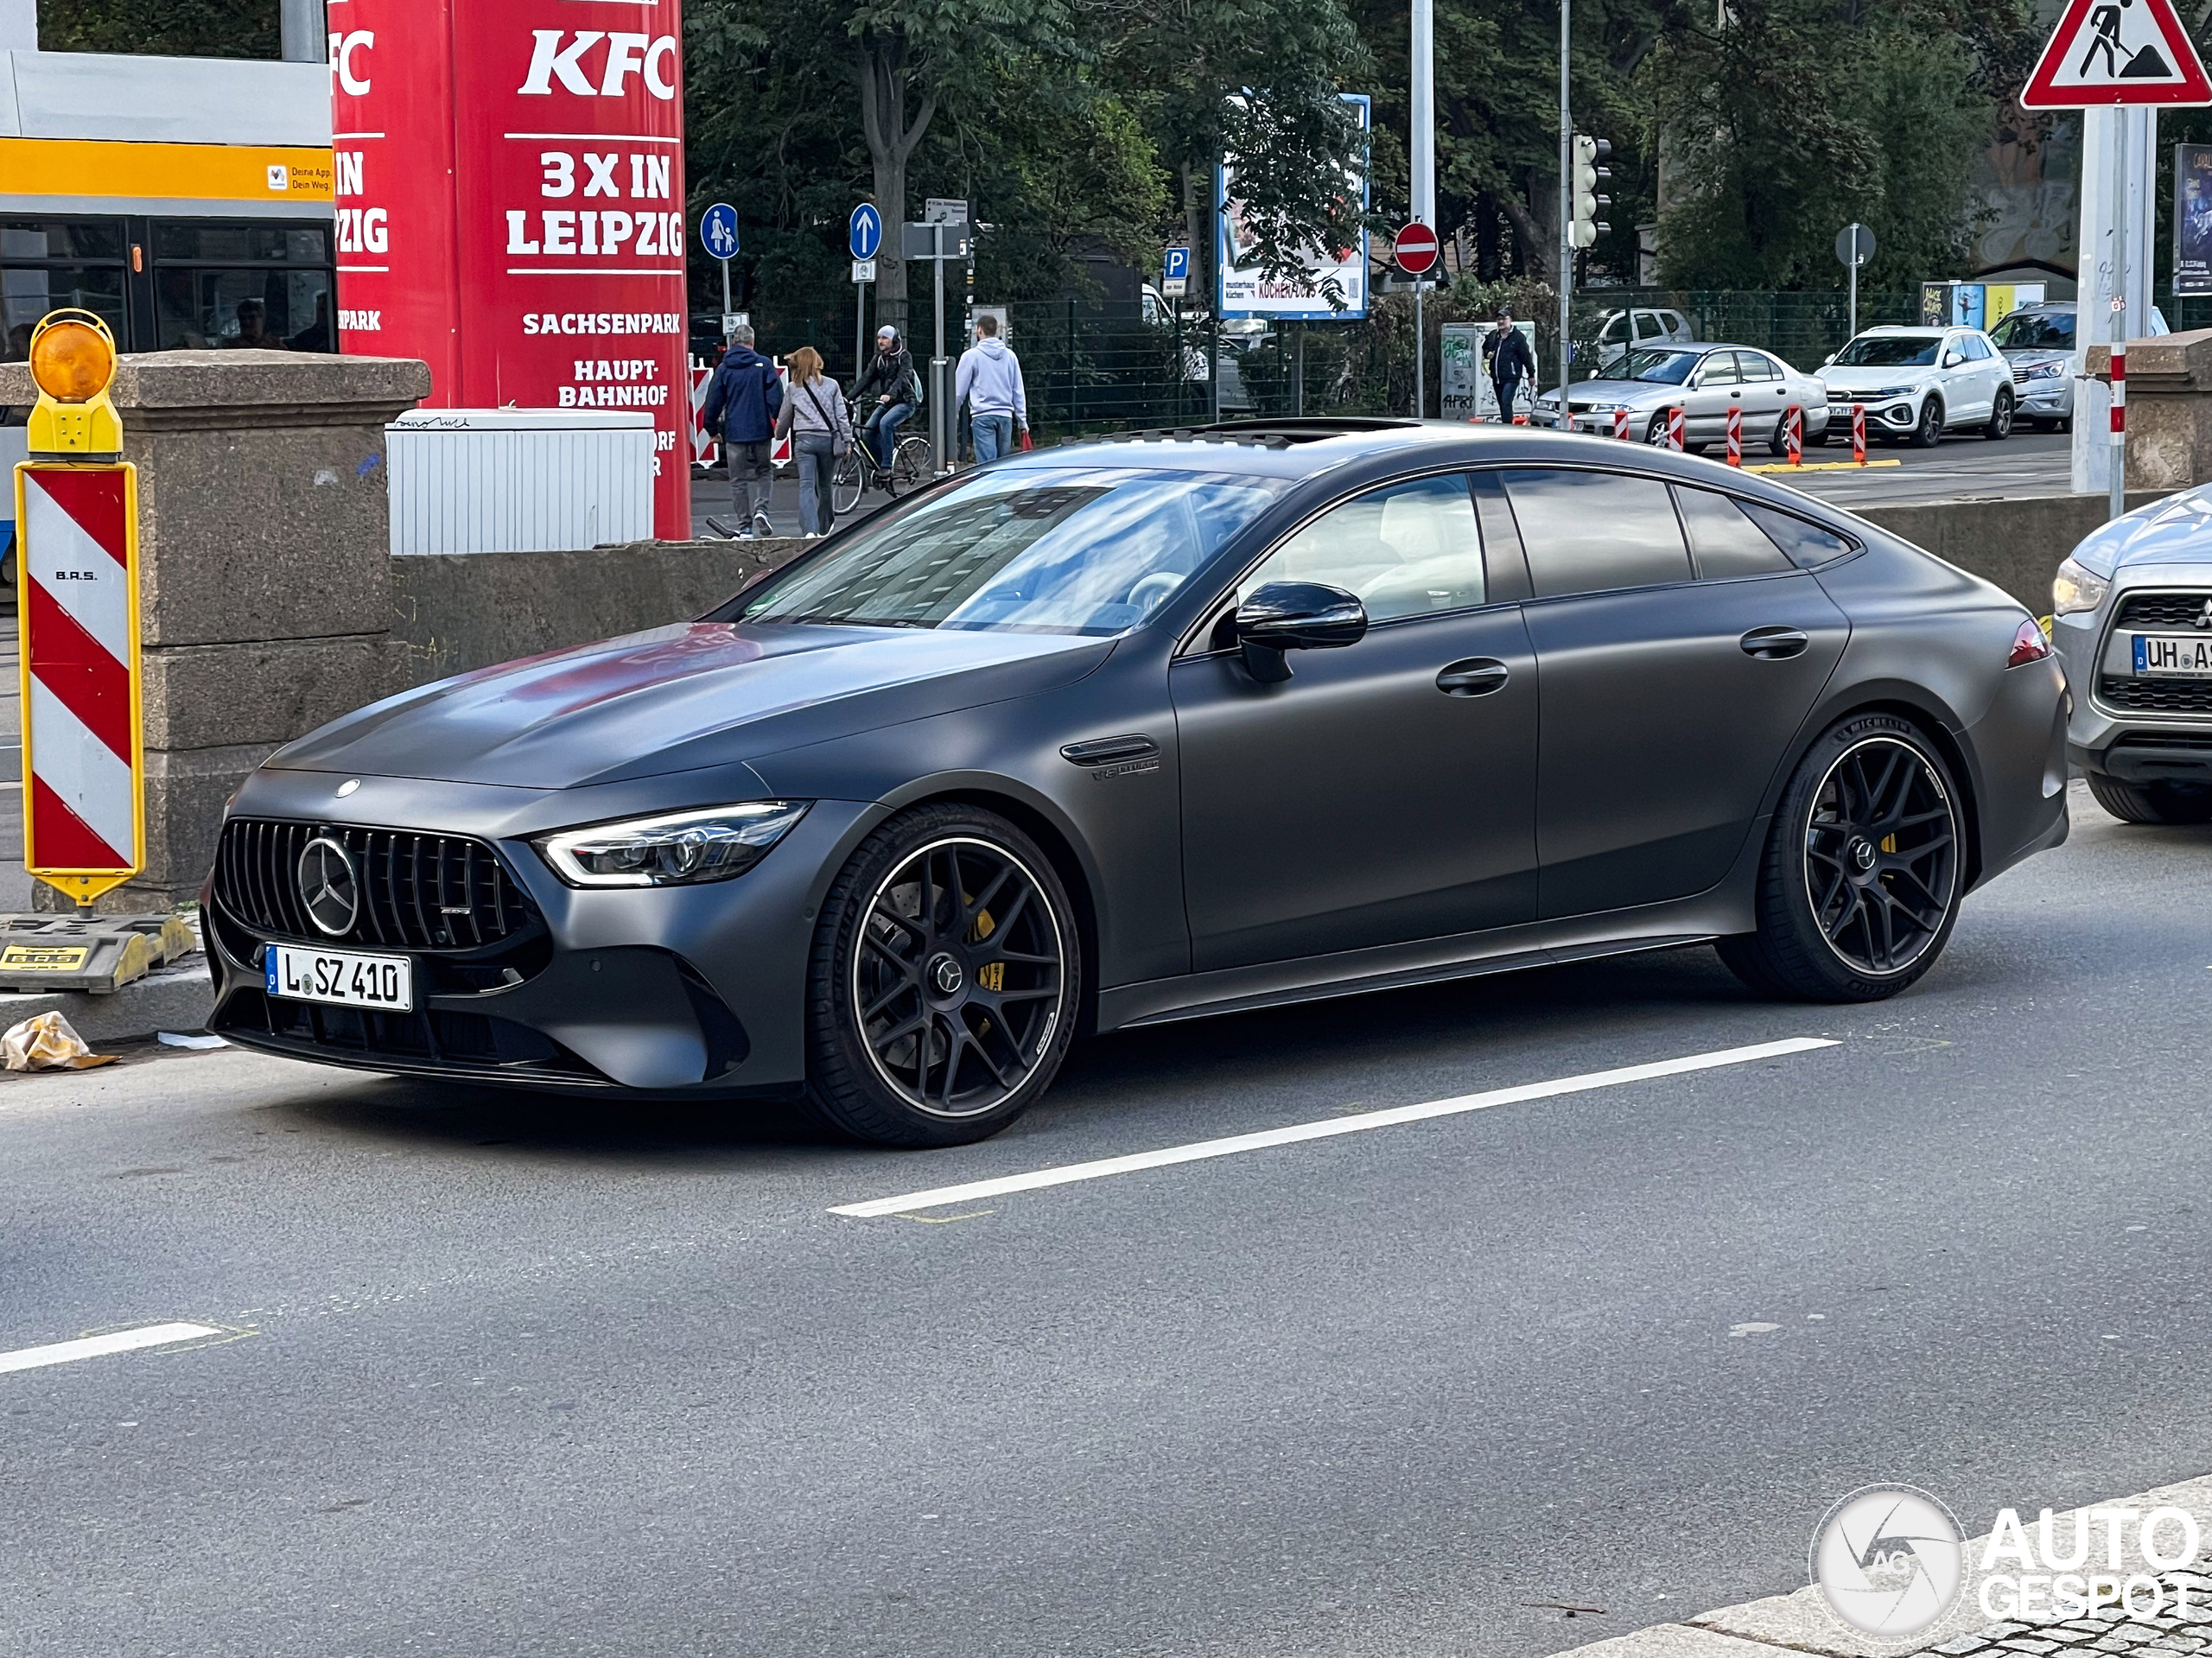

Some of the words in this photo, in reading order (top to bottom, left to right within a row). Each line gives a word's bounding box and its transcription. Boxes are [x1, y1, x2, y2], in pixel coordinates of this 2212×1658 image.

[518, 29, 677, 100] KFC
[292, 167, 314, 175] Deine
[315, 168, 332, 178] App.
[335, 151, 364, 195] IN
[541, 151, 575, 198] 3
[583, 153, 620, 197] X
[630, 154, 670, 199] IN
[293, 180, 310, 189] Dein
[312, 181, 331, 191] Weg.
[505, 210, 683, 257] LEIPZIG
[1169, 251, 1184, 275] P
[523, 313, 680, 334] SACHSENPARK
[574, 359, 658, 381] HAUPT-
[558, 385, 668, 407] BAHNHOF
[56, 571, 98, 581] B.A.S.
[2138, 657, 2144, 665] D
[2147, 640, 2177, 668] UH
[2195, 642, 2212, 669] A
[1849, 718, 1909, 734] MICHELIN
[1118, 759, 1160, 774] BITURBO
[269, 974, 276, 985] D
[285, 953, 301, 992] L
[315, 957, 346, 998] SZ
[351, 962, 398, 1002] 410
